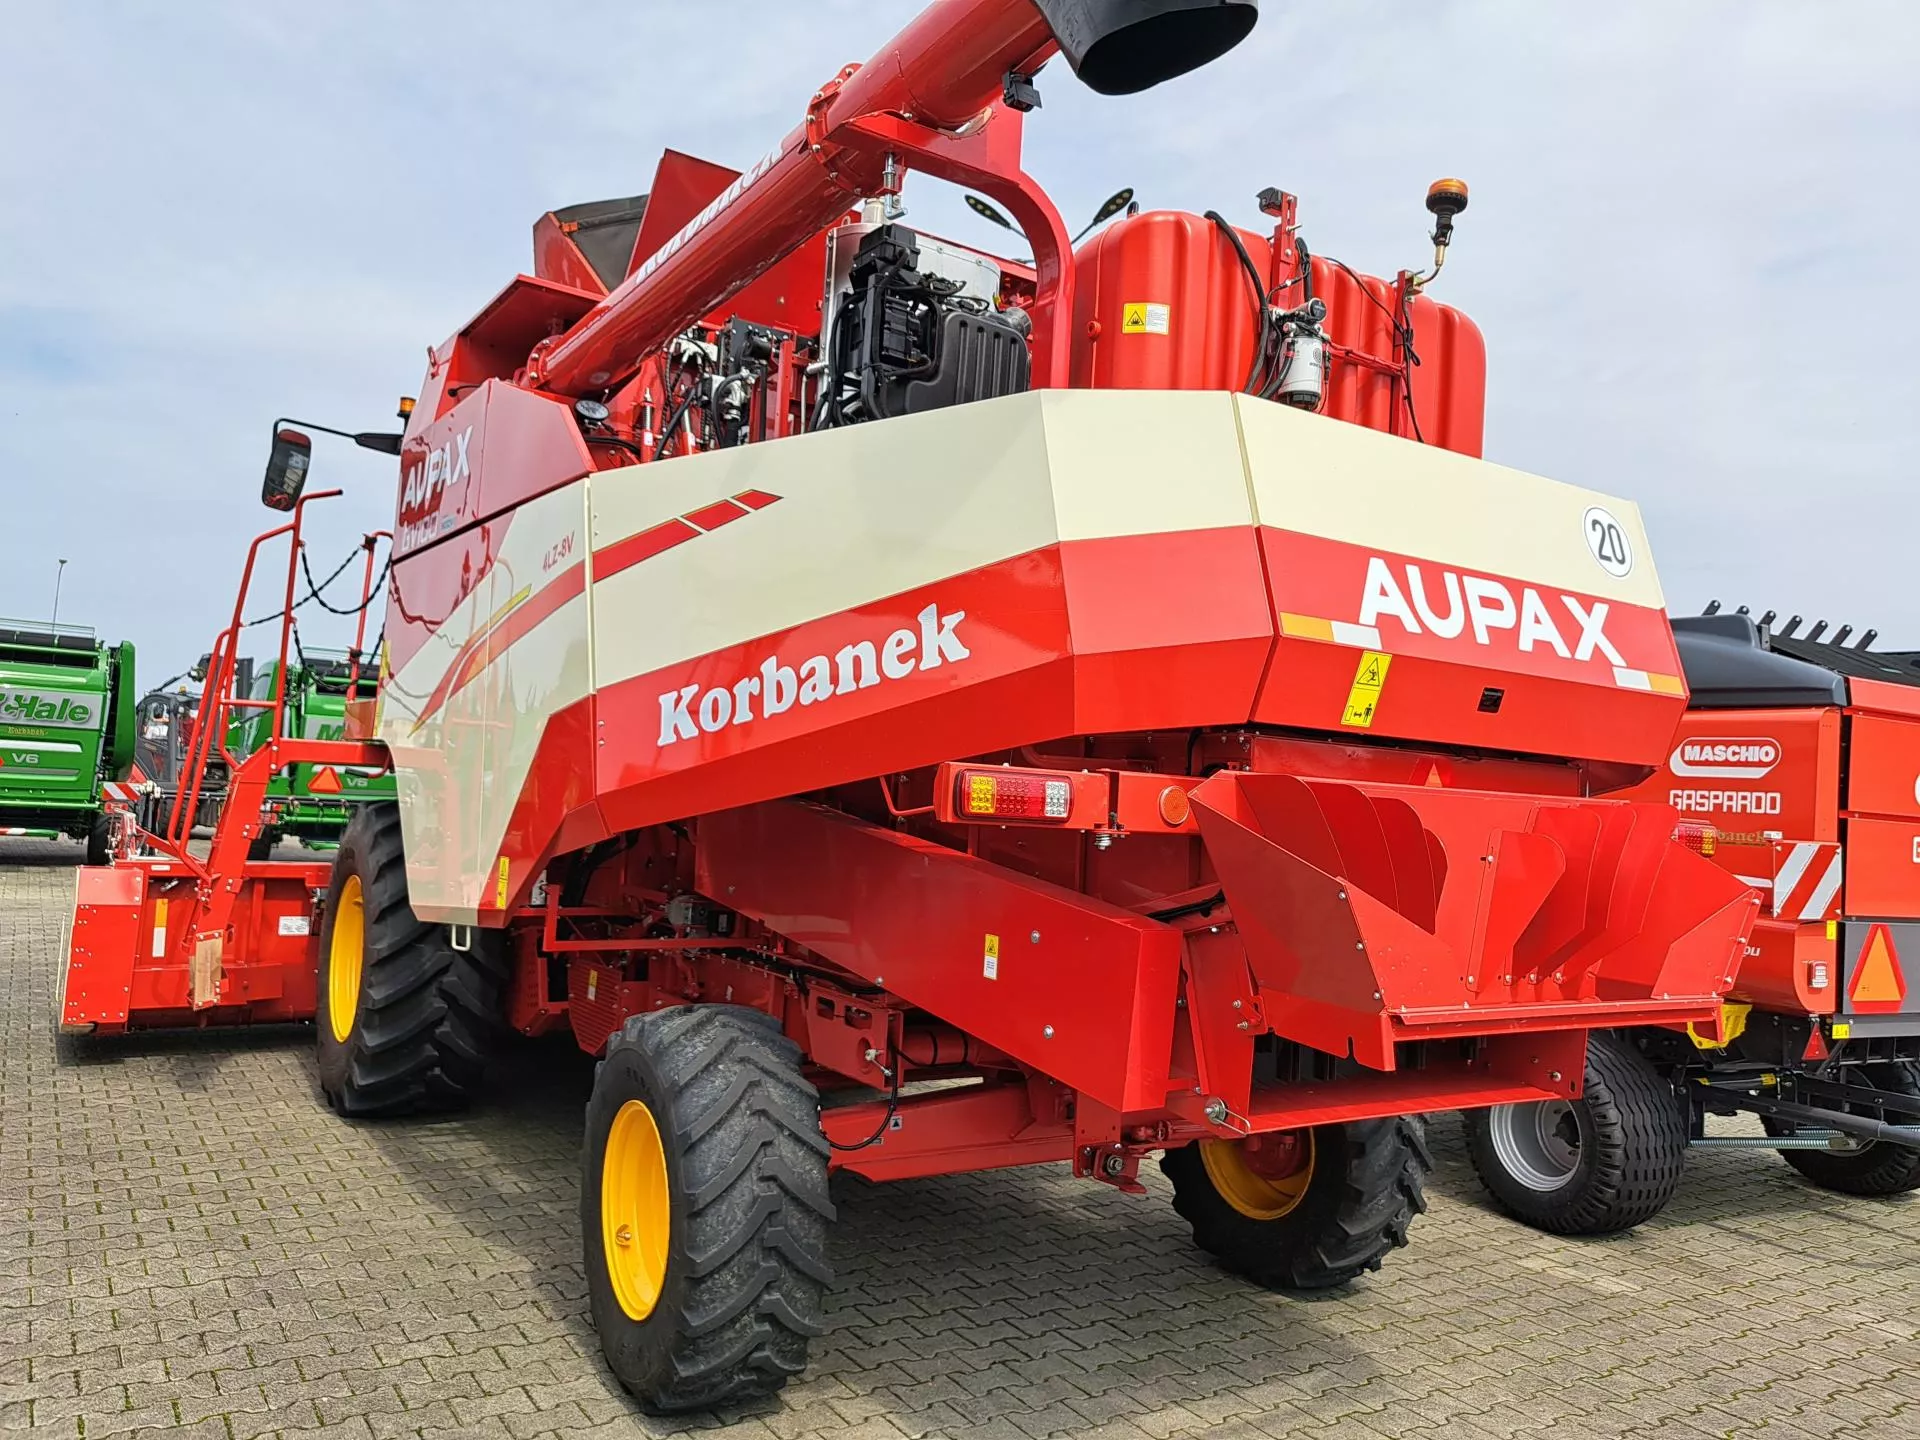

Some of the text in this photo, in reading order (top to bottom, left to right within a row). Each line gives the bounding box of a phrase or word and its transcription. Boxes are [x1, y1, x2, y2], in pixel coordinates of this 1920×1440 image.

[403, 426, 473, 511] AUPAX
[543, 529, 576, 573] 4LZ-8V
[1591, 519, 1626, 566] 20
[1359, 557, 1628, 667] AUPAX
[656, 602, 970, 746] Korbanek
[0, 693, 91, 723] cHale
[12, 752, 40, 764] V6
[1683, 744, 1776, 763] MASCHIO
[346, 776, 369, 787] V6
[1669, 789, 1781, 815] GASPARDO
